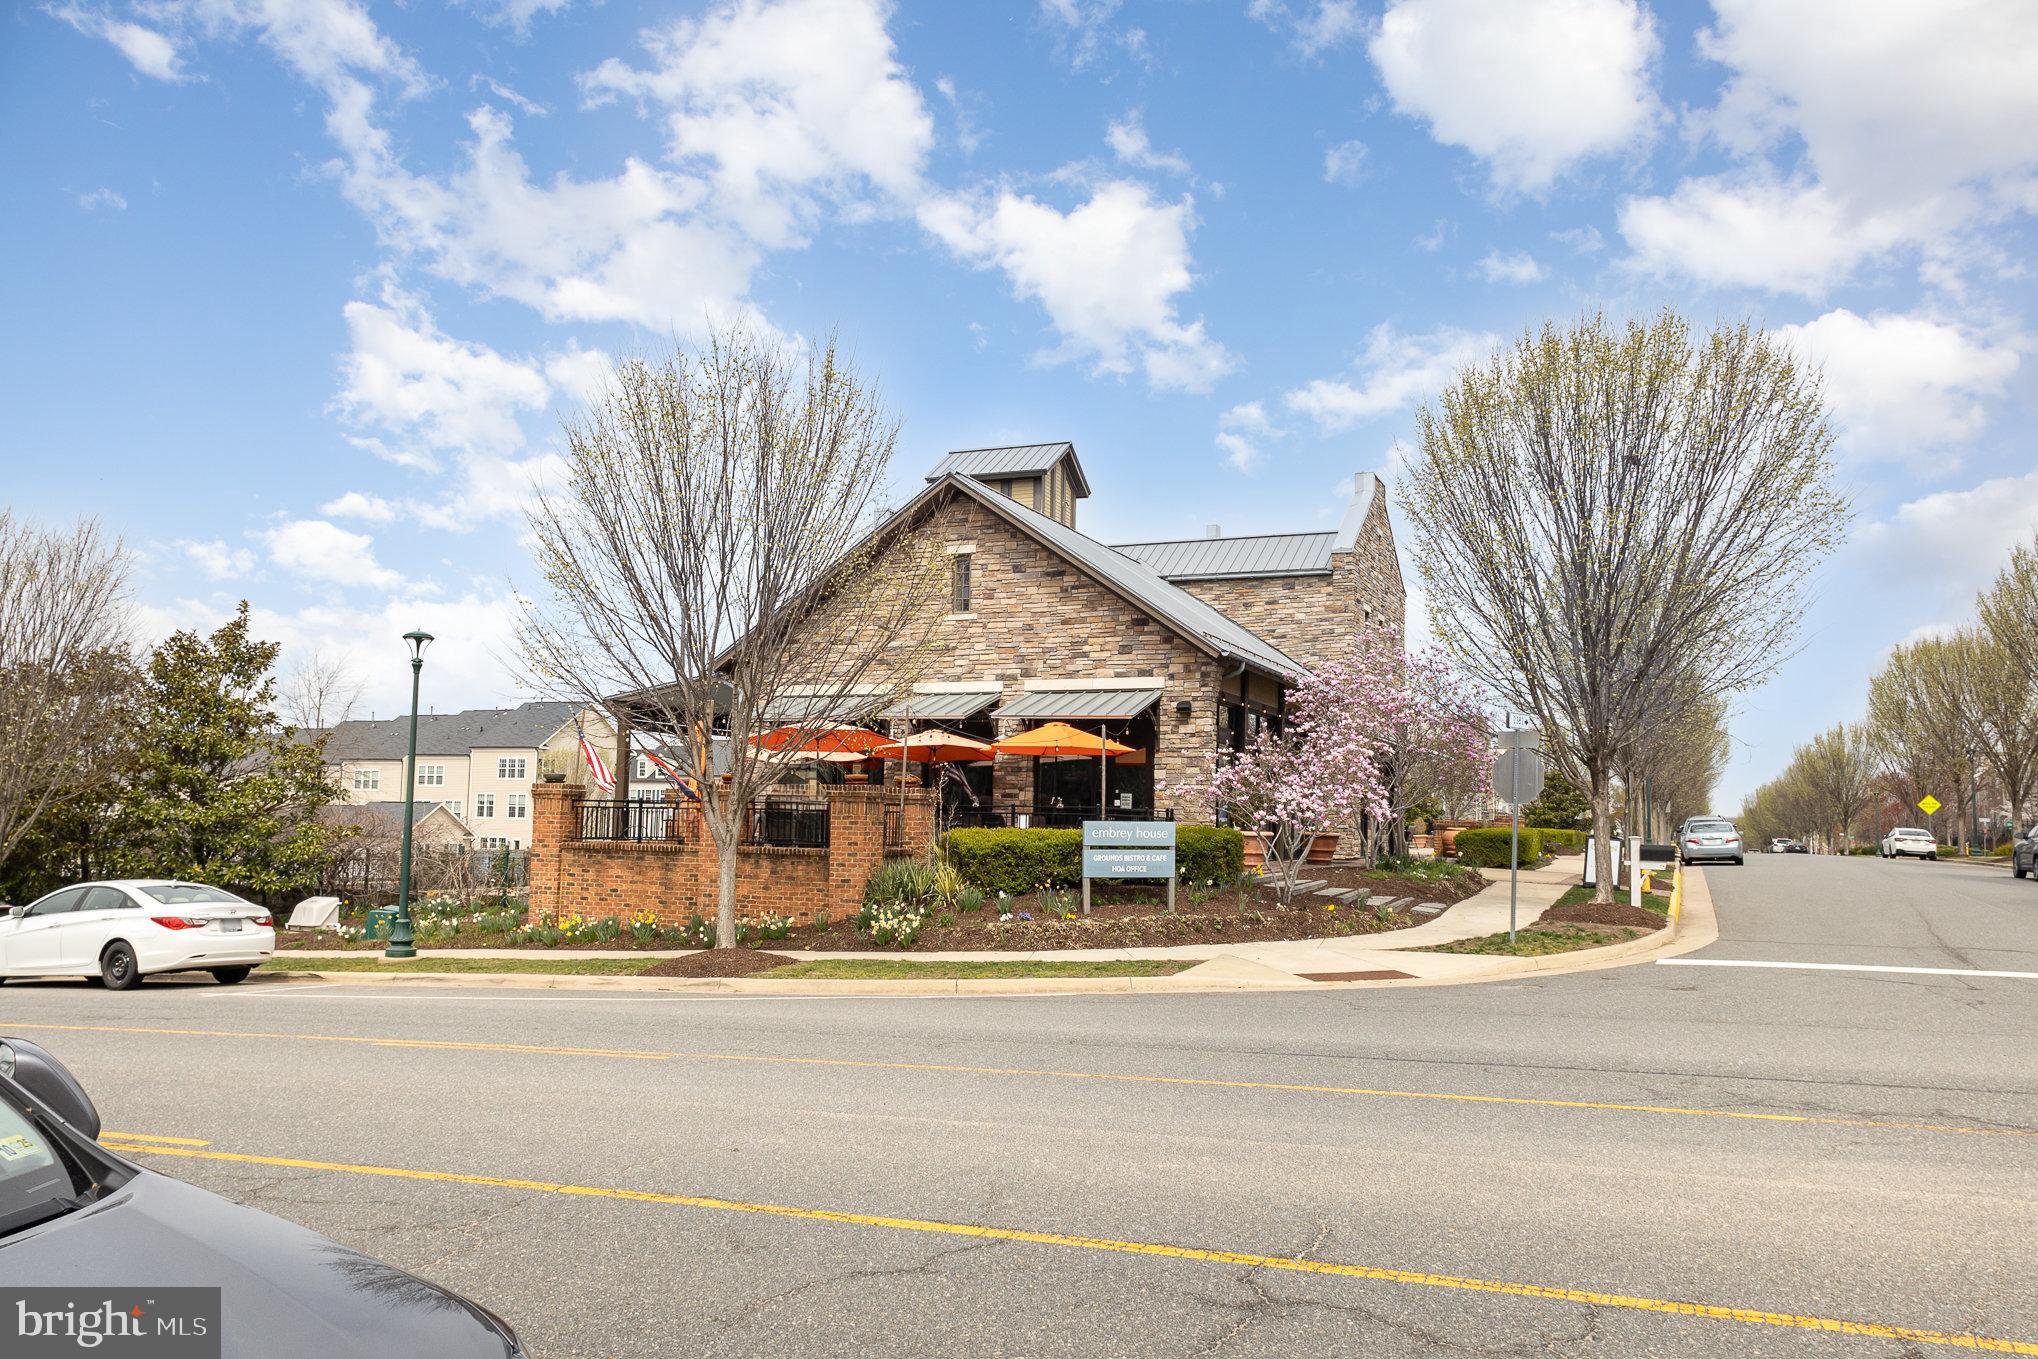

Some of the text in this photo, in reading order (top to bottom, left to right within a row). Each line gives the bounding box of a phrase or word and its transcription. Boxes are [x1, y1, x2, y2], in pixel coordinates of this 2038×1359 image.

[1092, 827, 1168, 841] embrey house
[1093, 854, 1123, 862] GROUNDS
[1123, 854, 1145, 862] BISTRO
